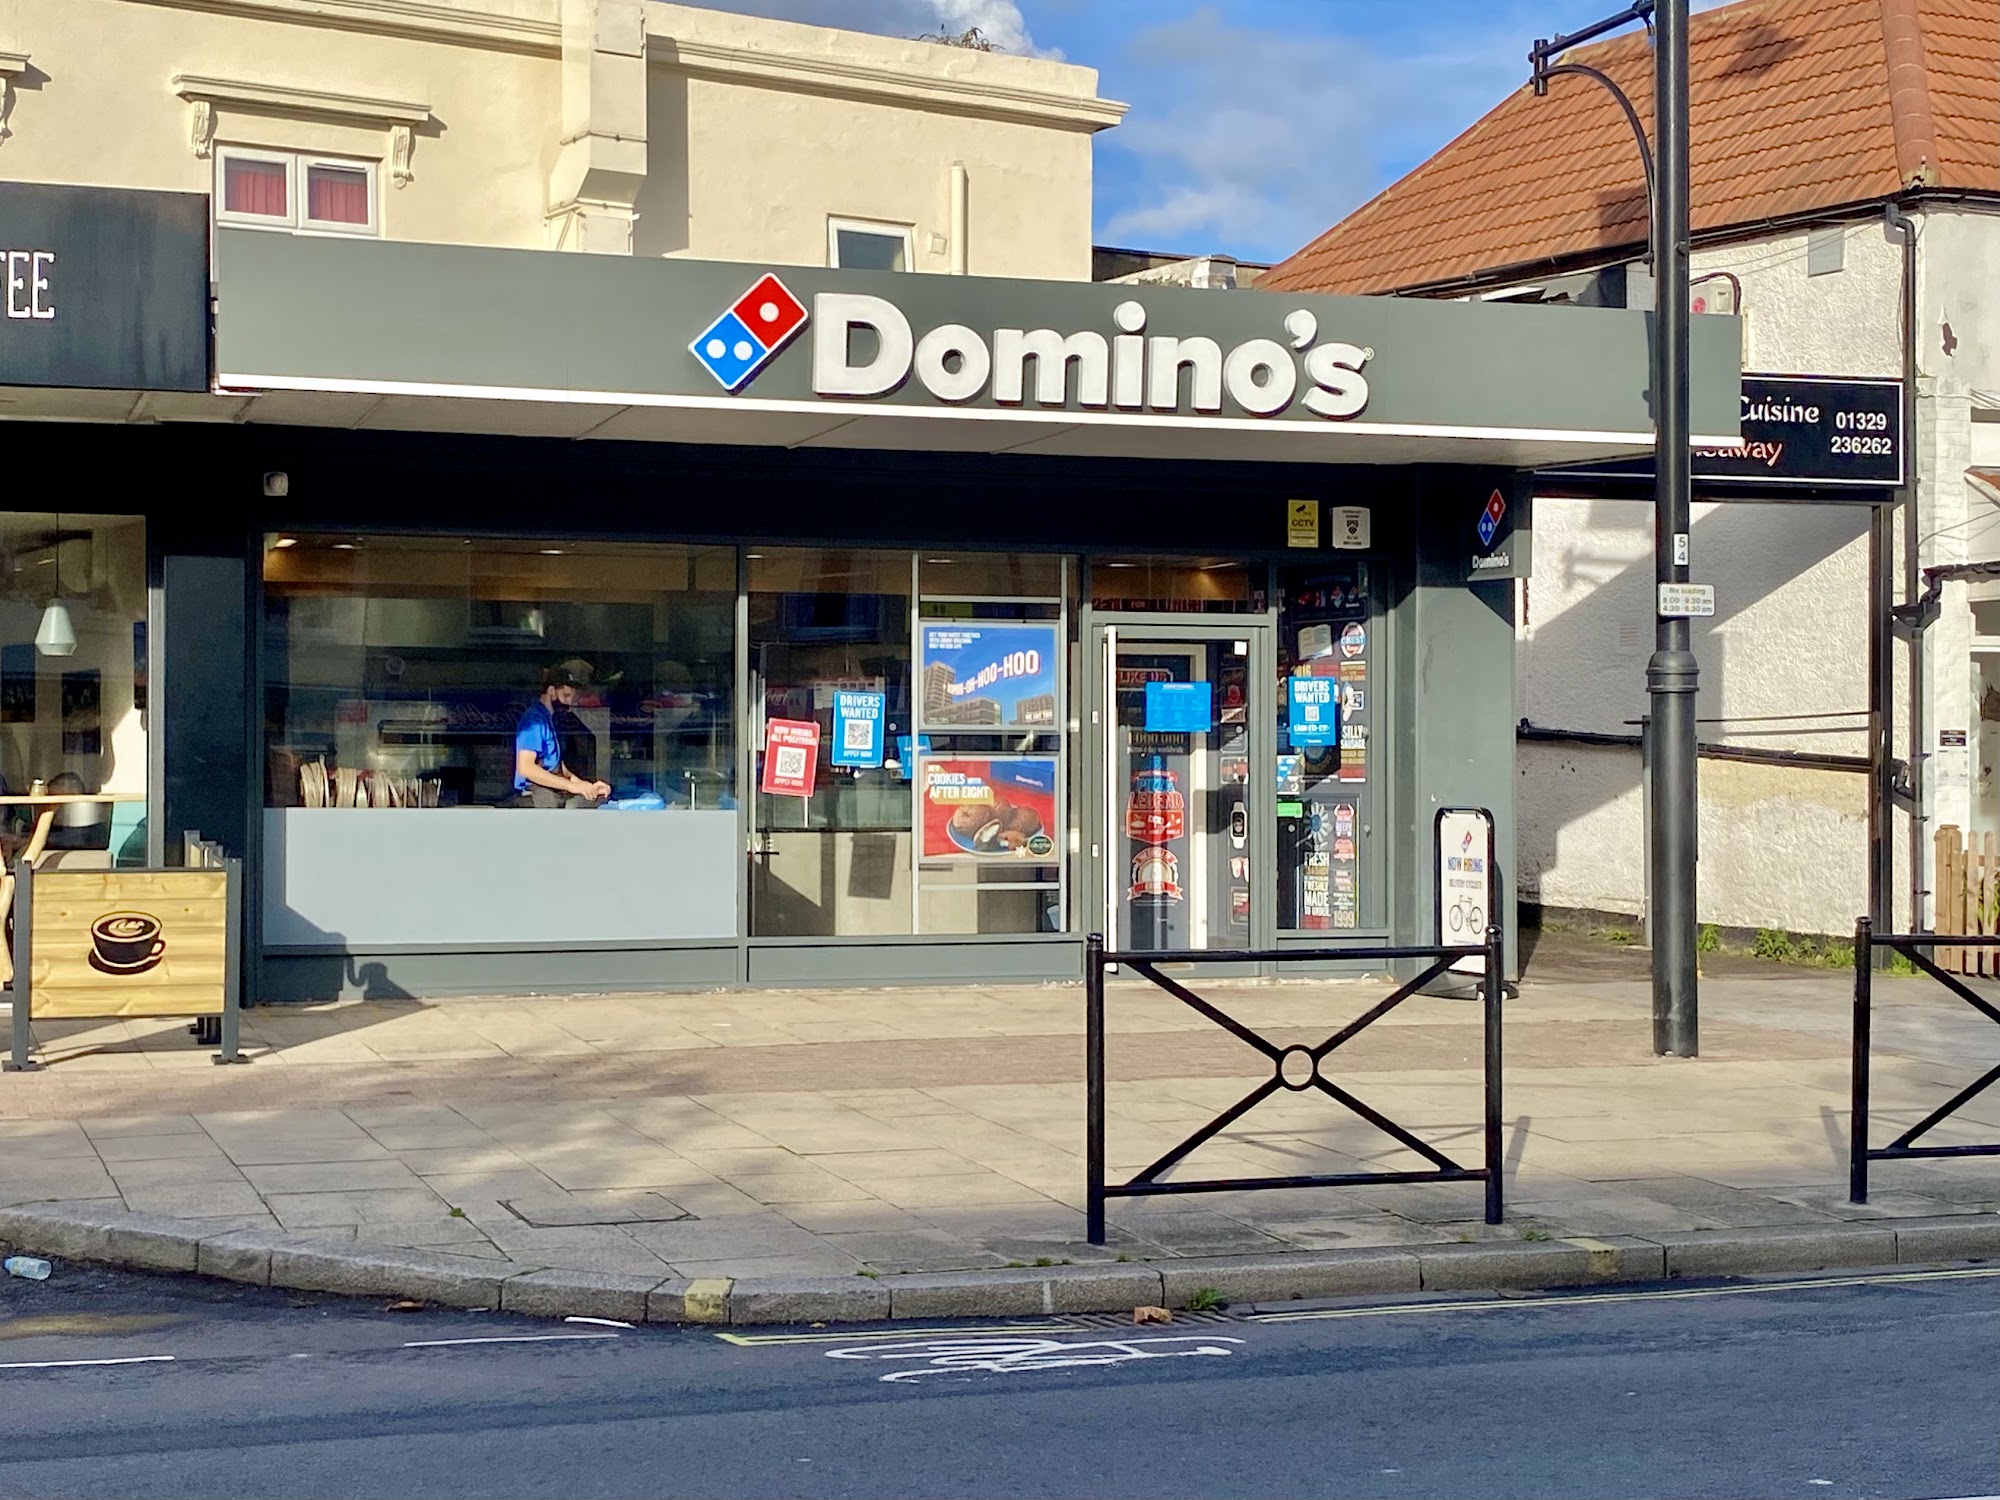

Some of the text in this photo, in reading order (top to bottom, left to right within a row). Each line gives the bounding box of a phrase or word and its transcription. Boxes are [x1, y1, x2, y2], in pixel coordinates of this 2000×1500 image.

[0, 251, 55, 318] EE
[813, 292, 1370, 420] Domino's
[1835, 412, 1887, 430] 01329
[1830, 437, 1892, 454] 236262
[1291, 519, 1315, 527] CCTV
[1678, 536, 1687, 548] 5
[1678, 552, 1686, 563] 4
[1294, 681, 1330, 692] DRIVERS
[840, 694, 880, 708] DRIVERS
[1295, 692, 1331, 703] WANTED
[841, 707, 879, 719] WANTED
[1342, 725, 1363, 738] SILLY
[928, 773, 966, 785] COOKIES
[929, 786, 989, 798] AFTER EIGHT
[1304, 891, 1329, 906] MADE
[1333, 911, 1355, 928] 1999
